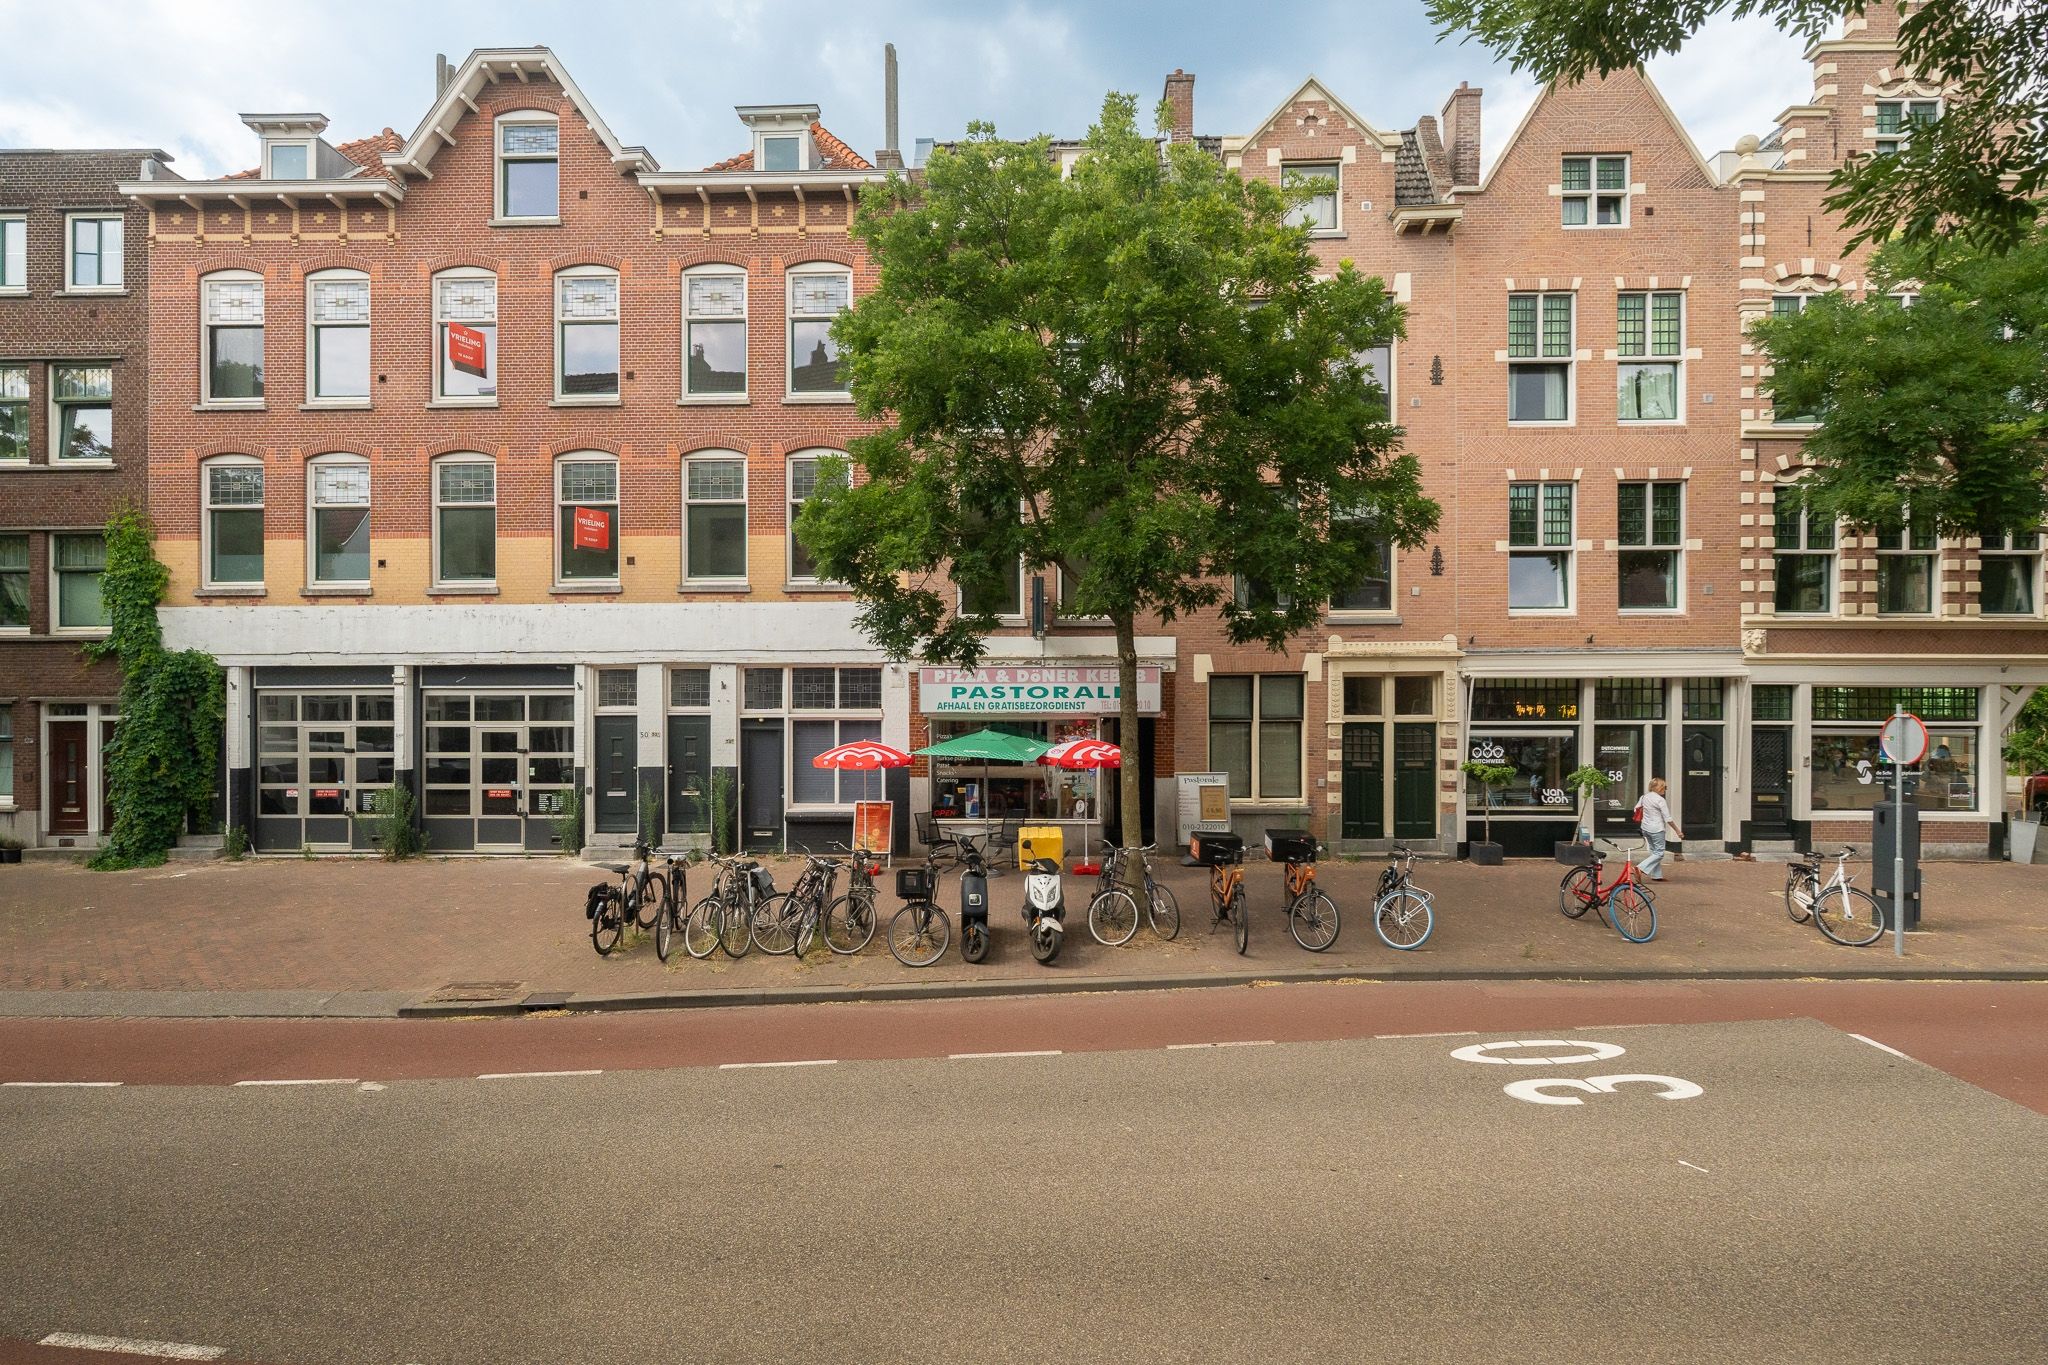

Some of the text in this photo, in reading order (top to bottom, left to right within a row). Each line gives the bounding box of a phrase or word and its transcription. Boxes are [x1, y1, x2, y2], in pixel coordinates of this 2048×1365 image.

[450, 331, 481, 348] VRIELING
[577, 517, 605, 528] VRIELING
[994, 670, 1011, 683] &
[1087, 670, 1147, 683] KEBB
[937, 701, 1086, 710] AFHAAL EN GRATISBEZORGDIENST
[1184, 776, 1219, 784] Pastorale
[1608, 770, 1623, 782] 58
[934, 809, 958, 817] OPEN
